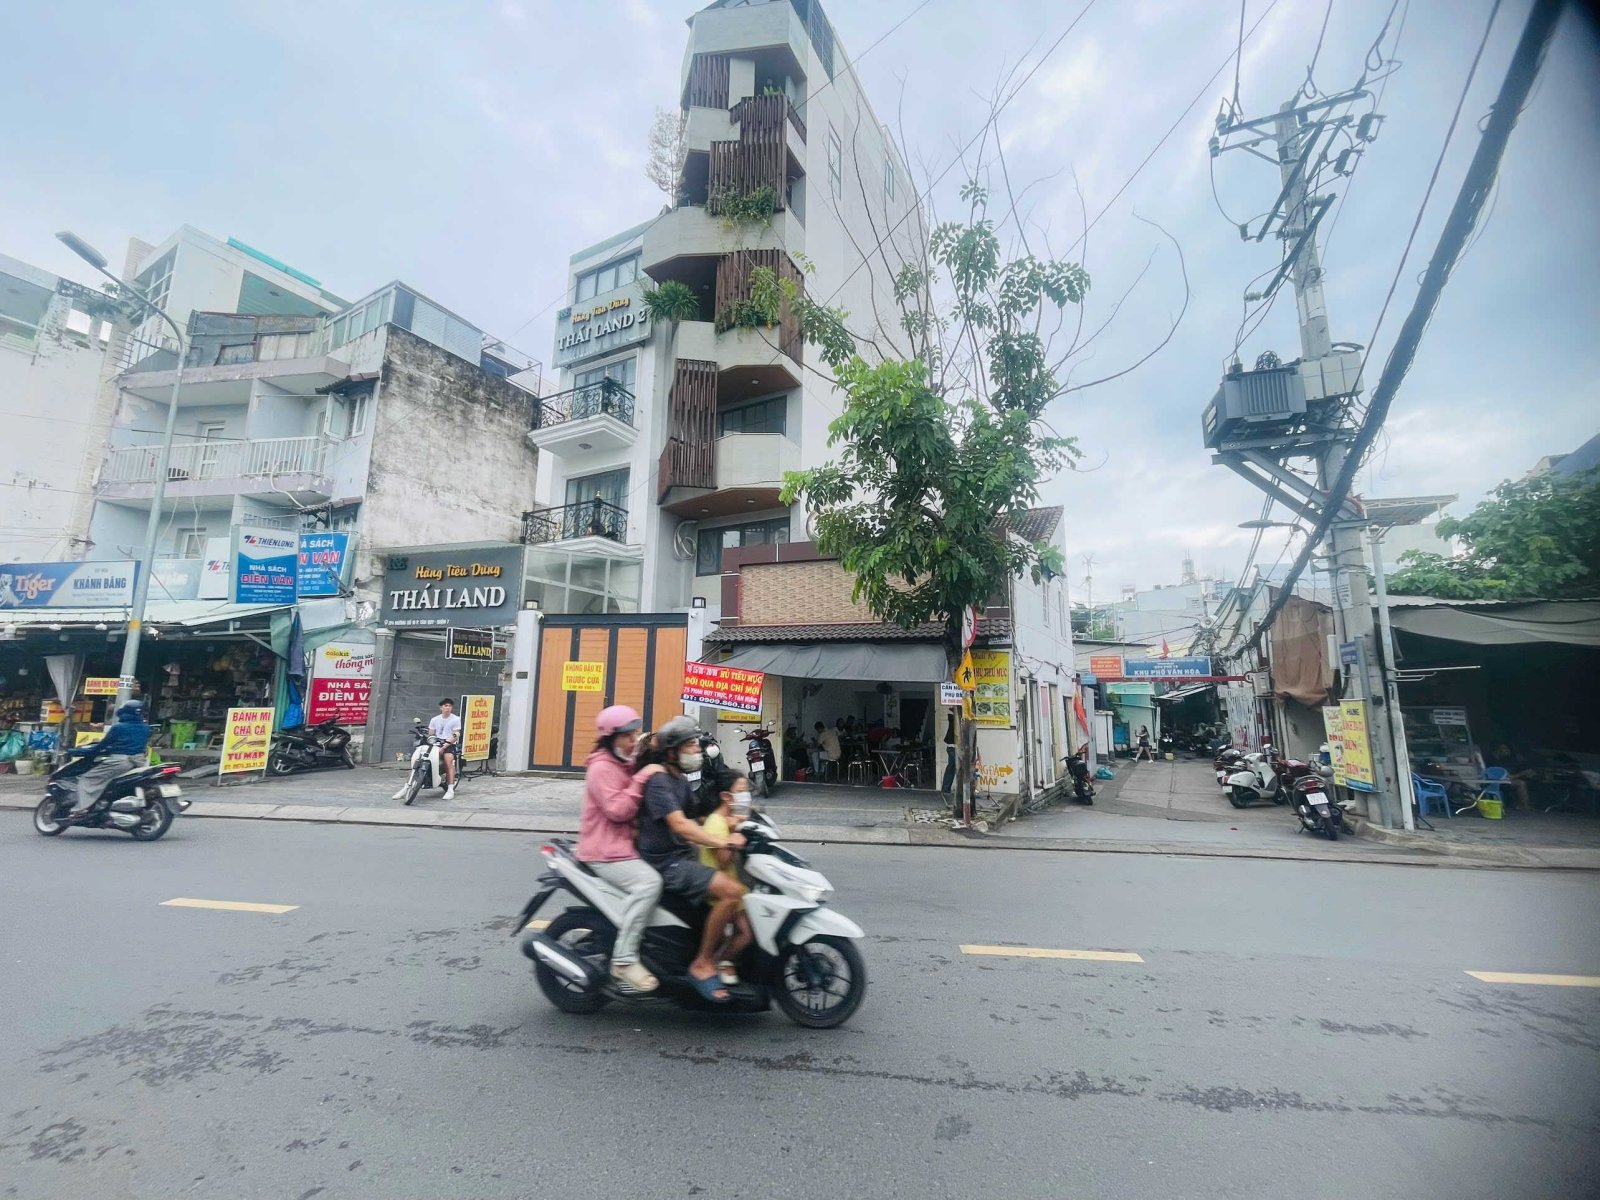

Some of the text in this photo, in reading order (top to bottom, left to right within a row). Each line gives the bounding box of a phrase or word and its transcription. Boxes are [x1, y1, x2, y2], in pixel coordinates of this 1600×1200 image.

[559, 307, 647, 351] THÁI LAND 2
[310, 538, 334, 548] SÁCH
[267, 565, 287, 573] SÁCH
[415, 562, 502, 581] Hàng Tiêu Dùng
[73, 576, 102, 590] KHÁNH
[241, 571, 269, 584] ĐIỀN
[15, 572, 57, 600] Tiger
[390, 582, 506, 610] THÁI LAND
[453, 642, 492, 657] THÁI LAND
[335, 658, 365, 673] thông
[565, 663, 582, 672] KHÔNG
[595, 664, 602, 672] XE
[327, 680, 351, 689] NHÀ
[566, 674, 600, 684] TRƯỚC CỬA
[700, 679, 714, 689] QUA
[716, 682, 729, 691] ĐỊA
[730, 683, 744, 693] CHỈ
[745, 686, 760, 695] MỚI
[318, 689, 355, 701] ĐIỀN
[474, 697, 488, 707] CỬA
[683, 693, 757, 711] ĐT: 0909.860.169
[471, 710, 489, 718] HÀNG
